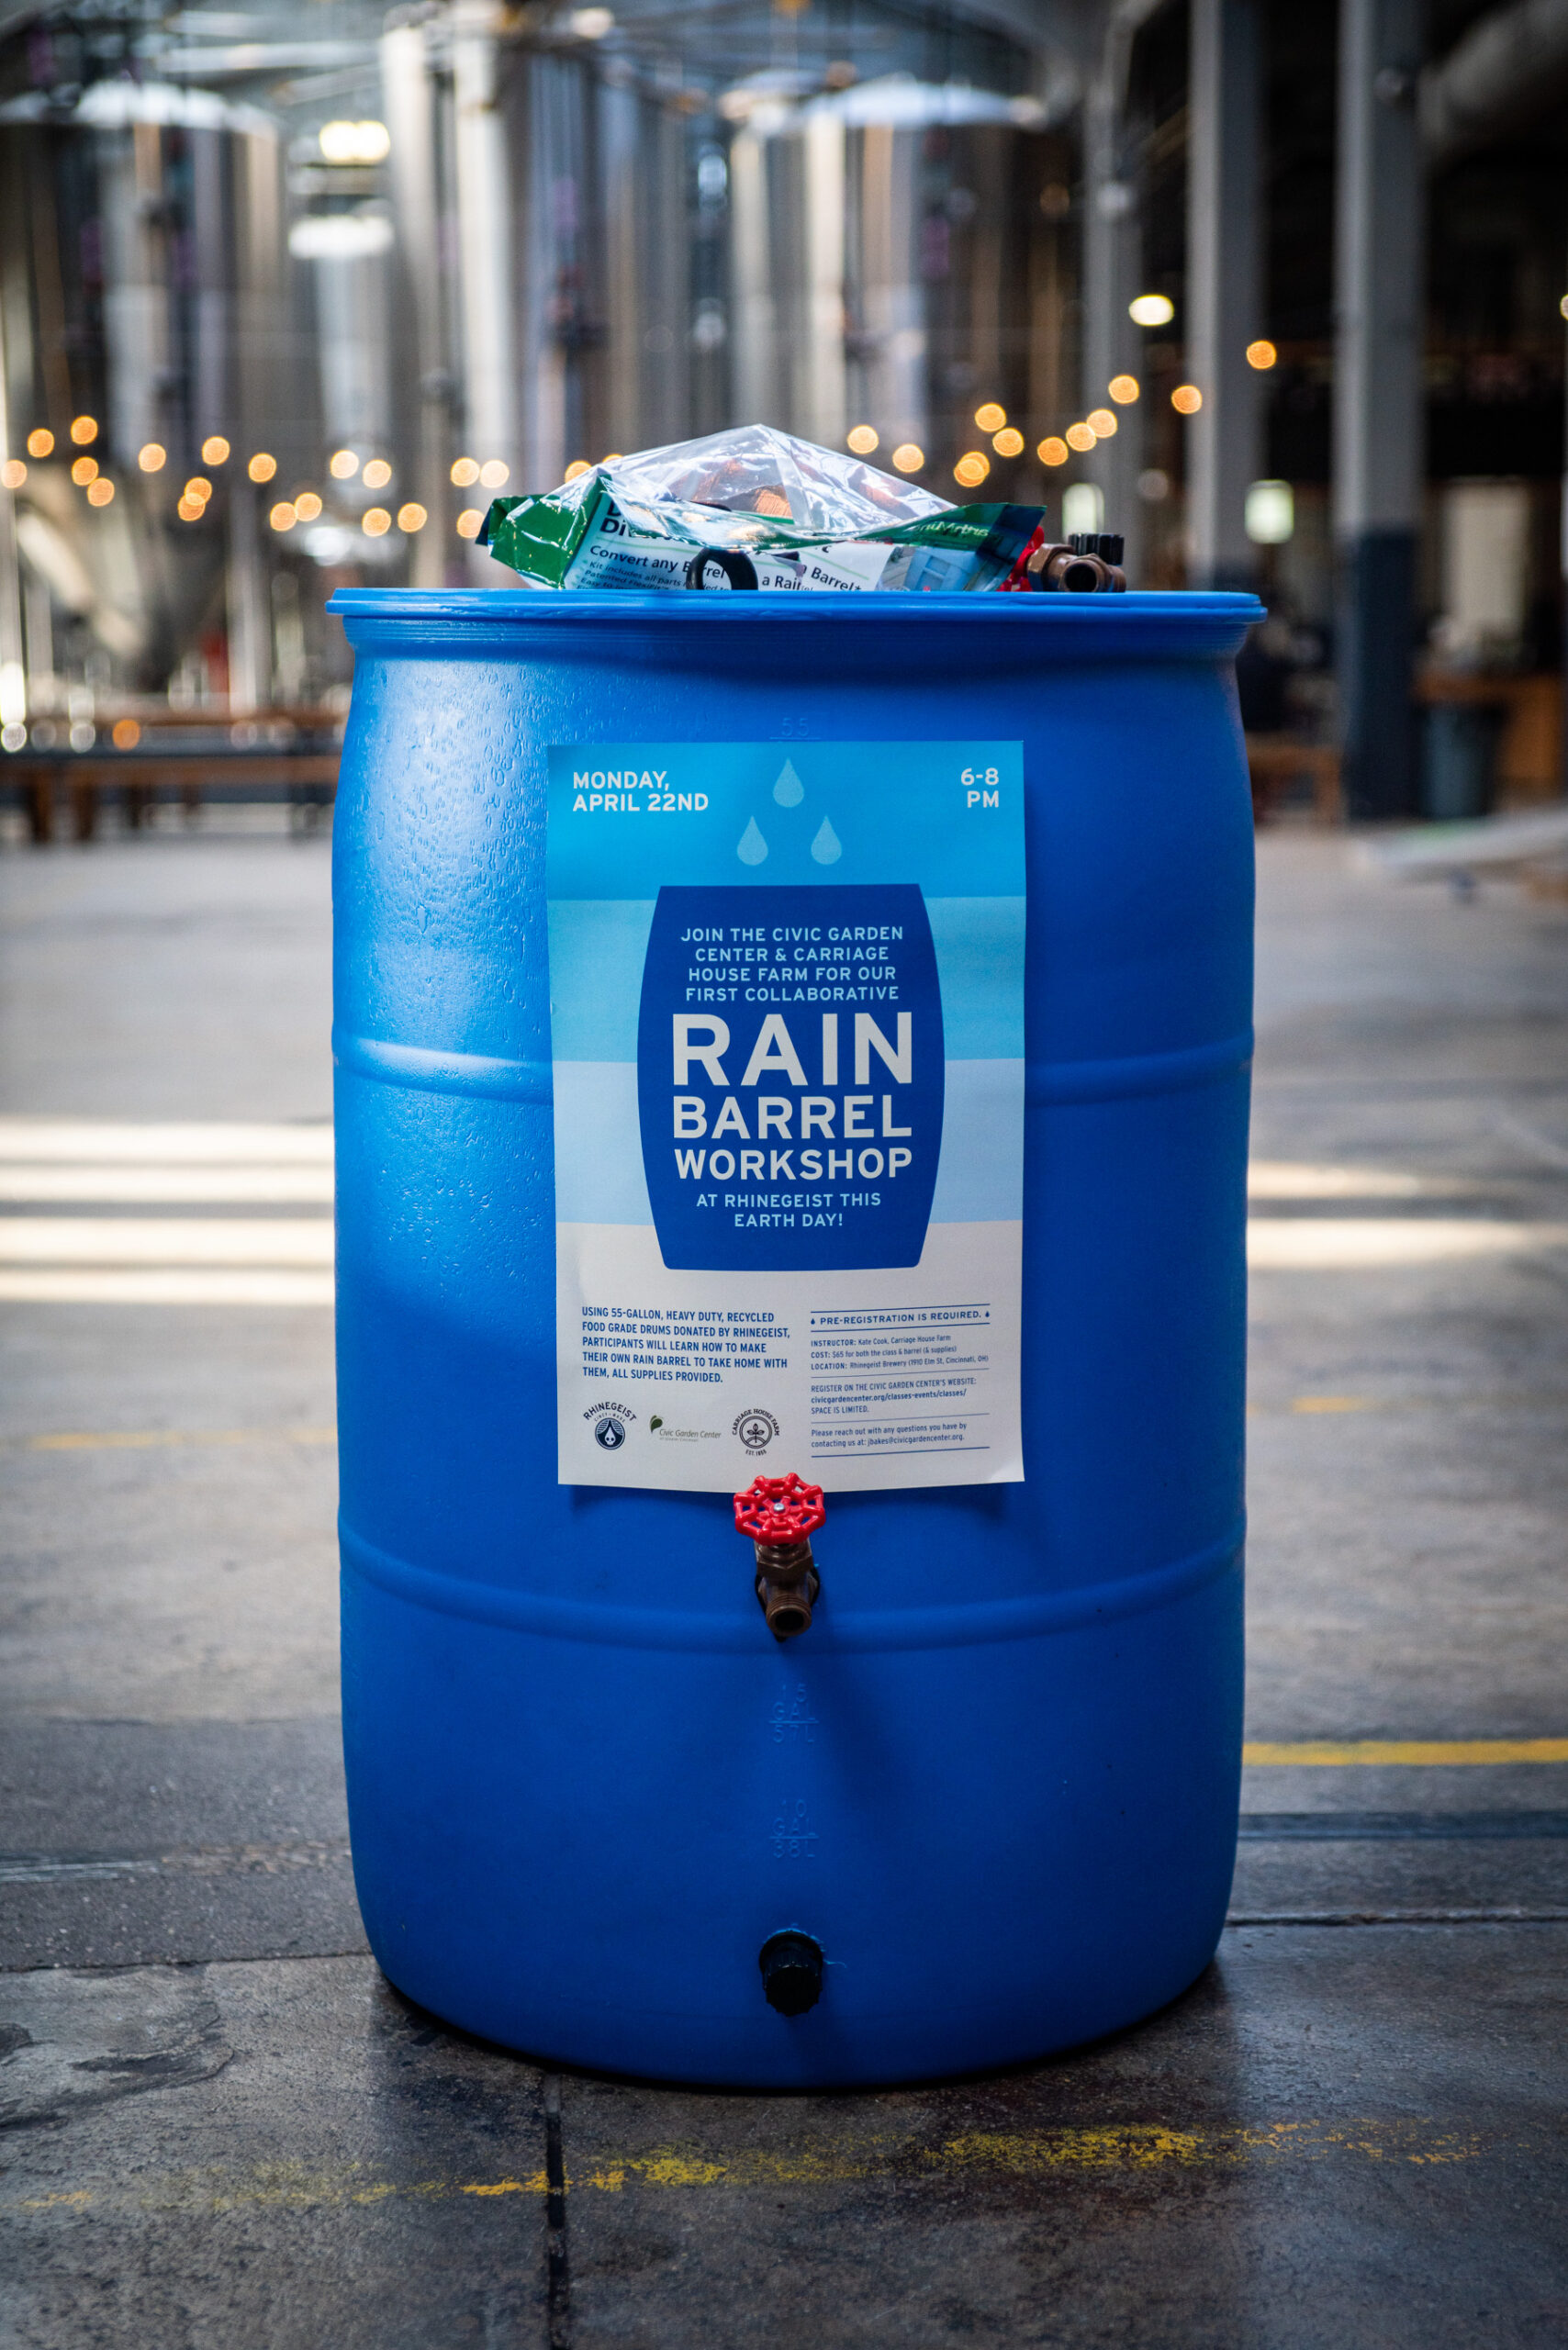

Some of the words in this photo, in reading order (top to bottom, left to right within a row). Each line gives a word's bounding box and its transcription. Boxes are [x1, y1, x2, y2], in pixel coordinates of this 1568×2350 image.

[589, 545, 647, 567] Convert
[652, 558, 678, 573] any
[682, 561, 725, 579] Brel
[762, 576, 770, 586] a
[585, 570, 626, 584] Patented
[606, 565, 643, 580] includes
[644, 575, 656, 585] all
[658, 577, 681, 588] parts
[781, 718, 809, 736] 55
[573, 771, 669, 791] MONDAY,
[961, 767, 1000, 786] 6-8
[573, 794, 640, 812] APRIL
[648, 794, 709, 811] 22ND
[967, 790, 1000, 809] PM
[680, 928, 723, 943] JOIN
[730, 928, 766, 942] THE
[772, 927, 821, 942] CIVIC
[827, 926, 903, 941] GARDEN
[696, 948, 767, 963] CENTER
[775, 948, 787, 962] &
[794, 946, 889, 962] CARRIAGE
[689, 968, 751, 982] HOUSE
[757, 968, 808, 982] FARM
[815, 968, 852, 981] FOR
[858, 967, 896, 981] OUR
[686, 988, 738, 1002] FIRST
[745, 986, 899, 1002] COLLABORATIVE
[673, 1012, 913, 1086] RAIN
[673, 1095, 913, 1139] BARREL
[675, 1147, 913, 1180] WORKSHOP
[696, 1194, 718, 1207] AT
[724, 1193, 834, 1208] RHINEGEIST
[840, 1192, 881, 1206] THIS
[734, 1214, 795, 1227] EARTH
[802, 1214, 843, 1226] DAY!
[582, 1306, 609, 1317] USING
[611, 1308, 664, 1320] 55-GALLON,
[666, 1311, 696, 1321] HEAVY
[699, 1312, 724, 1323] DUTY,
[728, 1313, 774, 1323] RECYCLED
[820, 1314, 914, 1325] PRE-REGISTRATION
[918, 1313, 927, 1321] IS
[931, 1311, 981, 1320] REQUIRED.
[582, 1322, 606, 1332] FOOD
[609, 1323, 637, 1334] GRADE
[640, 1325, 671, 1335] DRUMS
[674, 1326, 715, 1337] DONATED
[718, 1327, 730, 1337] BY
[734, 1328, 790, 1338] RHINEGEIST,
[583, 1337, 644, 1348] PARTICIPANTS
[646, 1340, 667, 1350] WILL
[670, 1341, 699, 1351] LEARN
[702, 1342, 723, 1352] HOW
[725, 1343, 737, 1352] TO
[740, 1343, 767, 1353] MAKE
[811, 1338, 857, 1347] INSTRUCTOR:
[891, 1336, 916, 1344] Carriage
[856, 1348, 868, 1357] both
[882, 1348, 897, 1356] class
[931, 1346, 957, 1354] supplies)
[583, 1352, 608, 1362] THEIR
[610, 1353, 631, 1364] OWN
[633, 1354, 654, 1365] RAIN
[656, 1356, 691, 1367] BARREL
[694, 1358, 705, 1367] TO
[709, 1358, 731, 1368] TAKE
[734, 1359, 760, 1368] HOME
[764, 1359, 788, 1368] WITH
[850, 1360, 881, 1369] Rhinegeist
[883, 1360, 906, 1368] Brewery
[946, 1356, 976, 1364] Cincinnati,
[583, 1367, 610, 1378] THEM,
[612, 1369, 628, 1379] ALL
[631, 1370, 673, 1381] SUPPLIES
[676, 1372, 723, 1383] PROVIDED.
[812, 1384, 842, 1393] REGISTER
[888, 1381, 915, 1390] GARDEN
[947, 1378, 976, 1386] WEBSITE:
[812, 1389, 967, 1404] civicgardencenter.org/classes-events/classes/
[584, 1402, 636, 1421] RHINEGEIST
[812, 1406, 831, 1415] SPACE
[842, 1405, 869, 1414] LIMITED.
[732, 1409, 753, 1435] CARRIAGE
[753, 1408, 773, 1419] HOUSE
[771, 1419, 779, 1436] FARM
[812, 1428, 833, 1437] Please
[834, 1427, 853, 1436] reach
[883, 1427, 895, 1436] any
[896, 1425, 927, 1435] questions
[929, 1425, 940, 1433] you
[942, 1423, 957, 1431] have
[958, 1423, 967, 1431] by
[812, 1438, 846, 1449] contacting
